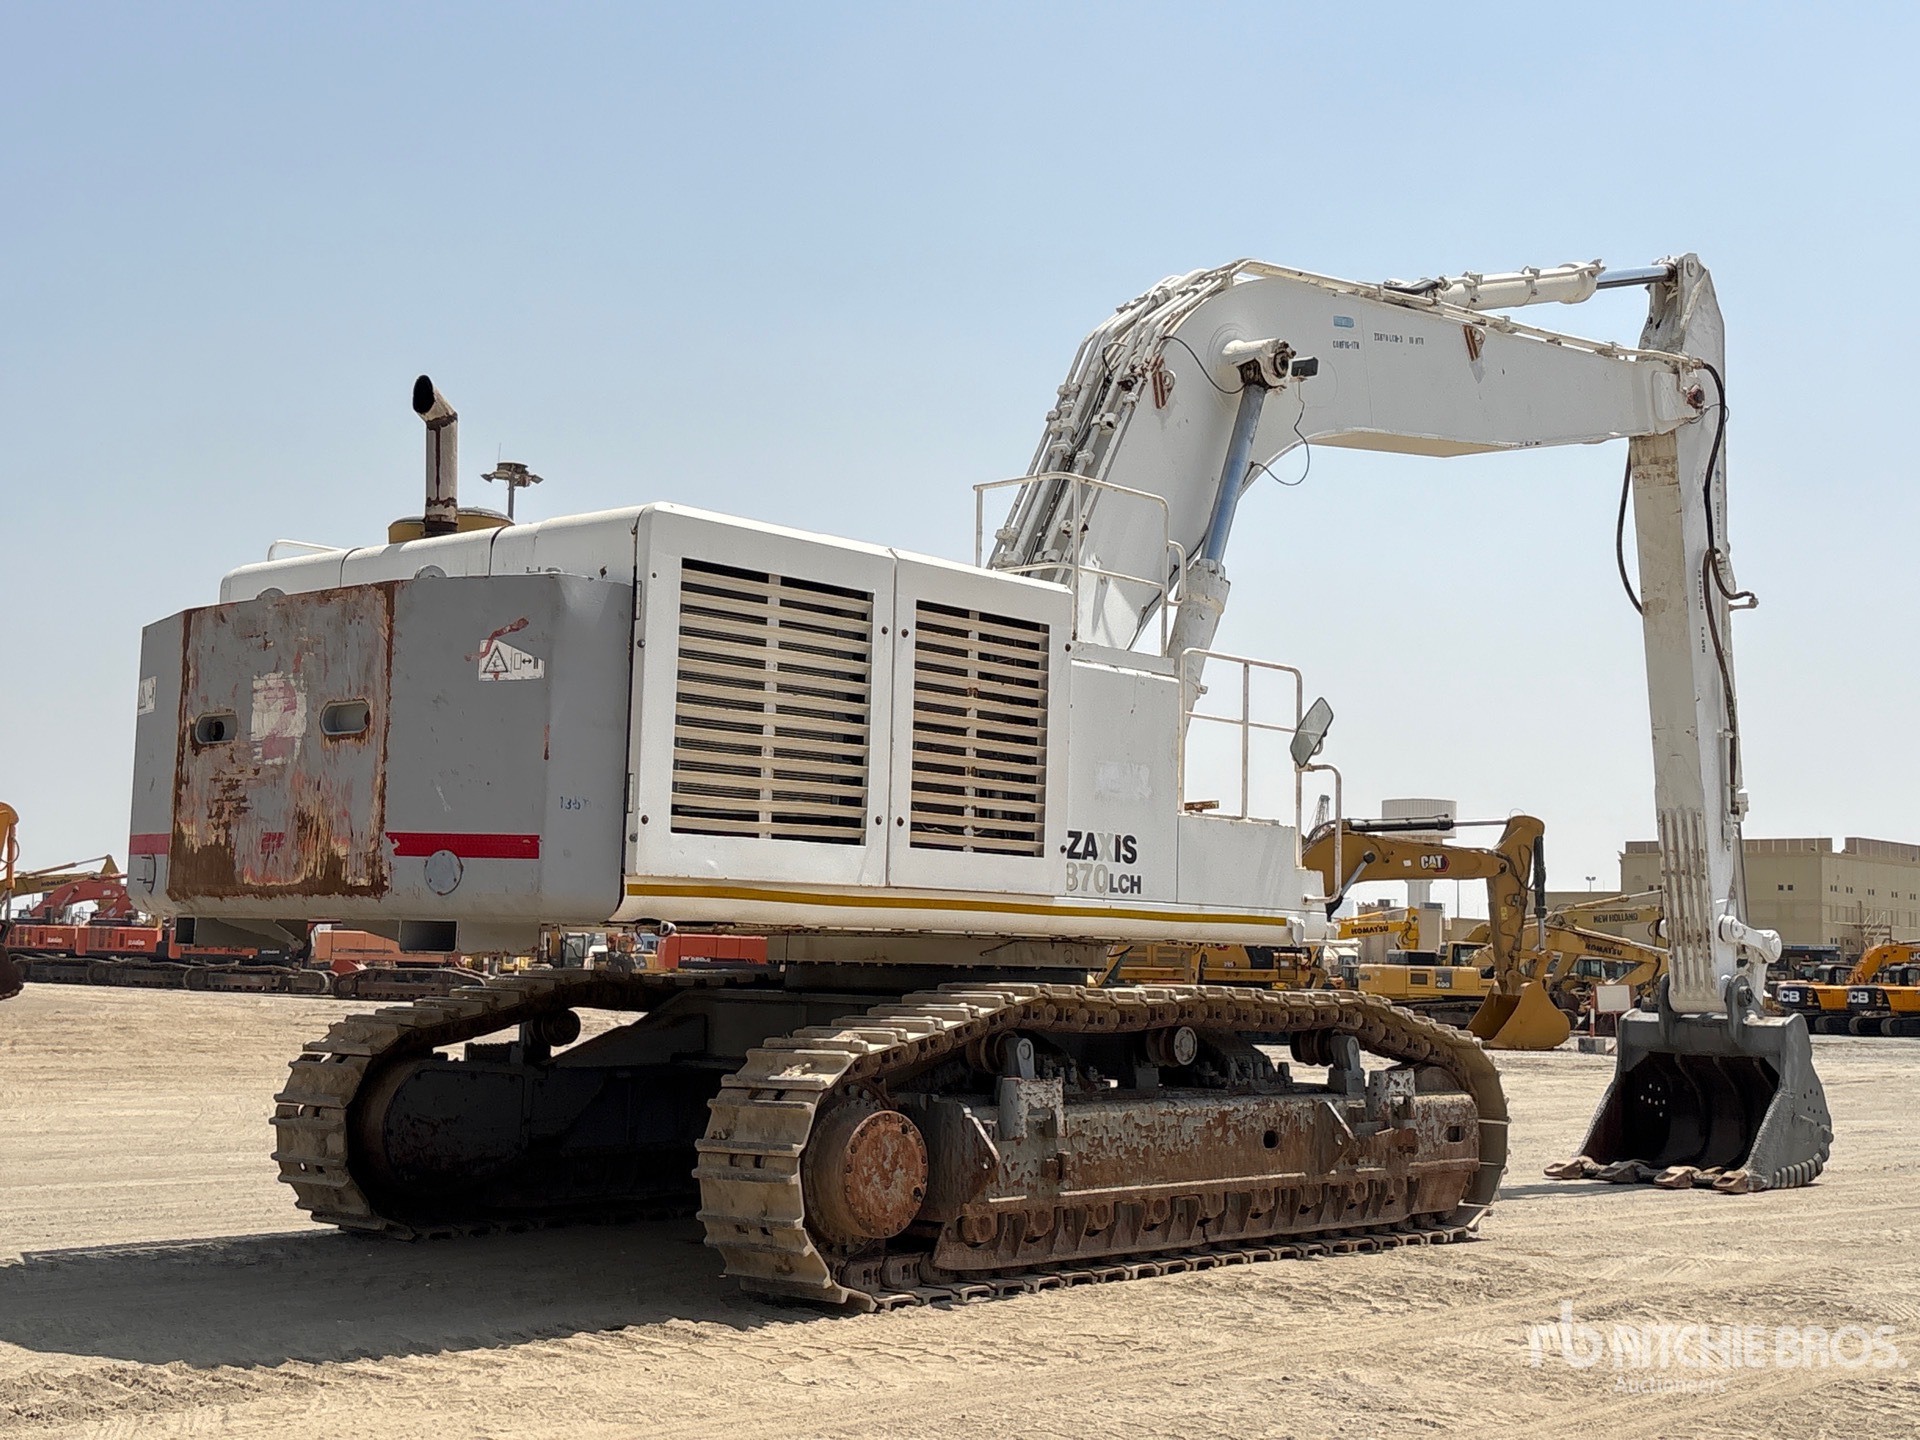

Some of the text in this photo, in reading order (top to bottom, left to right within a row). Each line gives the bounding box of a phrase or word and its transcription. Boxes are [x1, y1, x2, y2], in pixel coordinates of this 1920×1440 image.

[1066, 830, 1138, 864] ZAXIS
[1420, 855, 1443, 869] CAT
[1593, 912, 1638, 923] NEW HOLLAND
[1351, 924, 1389, 935] KOMATSU
[1585, 942, 1623, 956] KOMATSU
[1778, 990, 1800, 1003] JCB
[1847, 991, 1869, 1004] JCB
